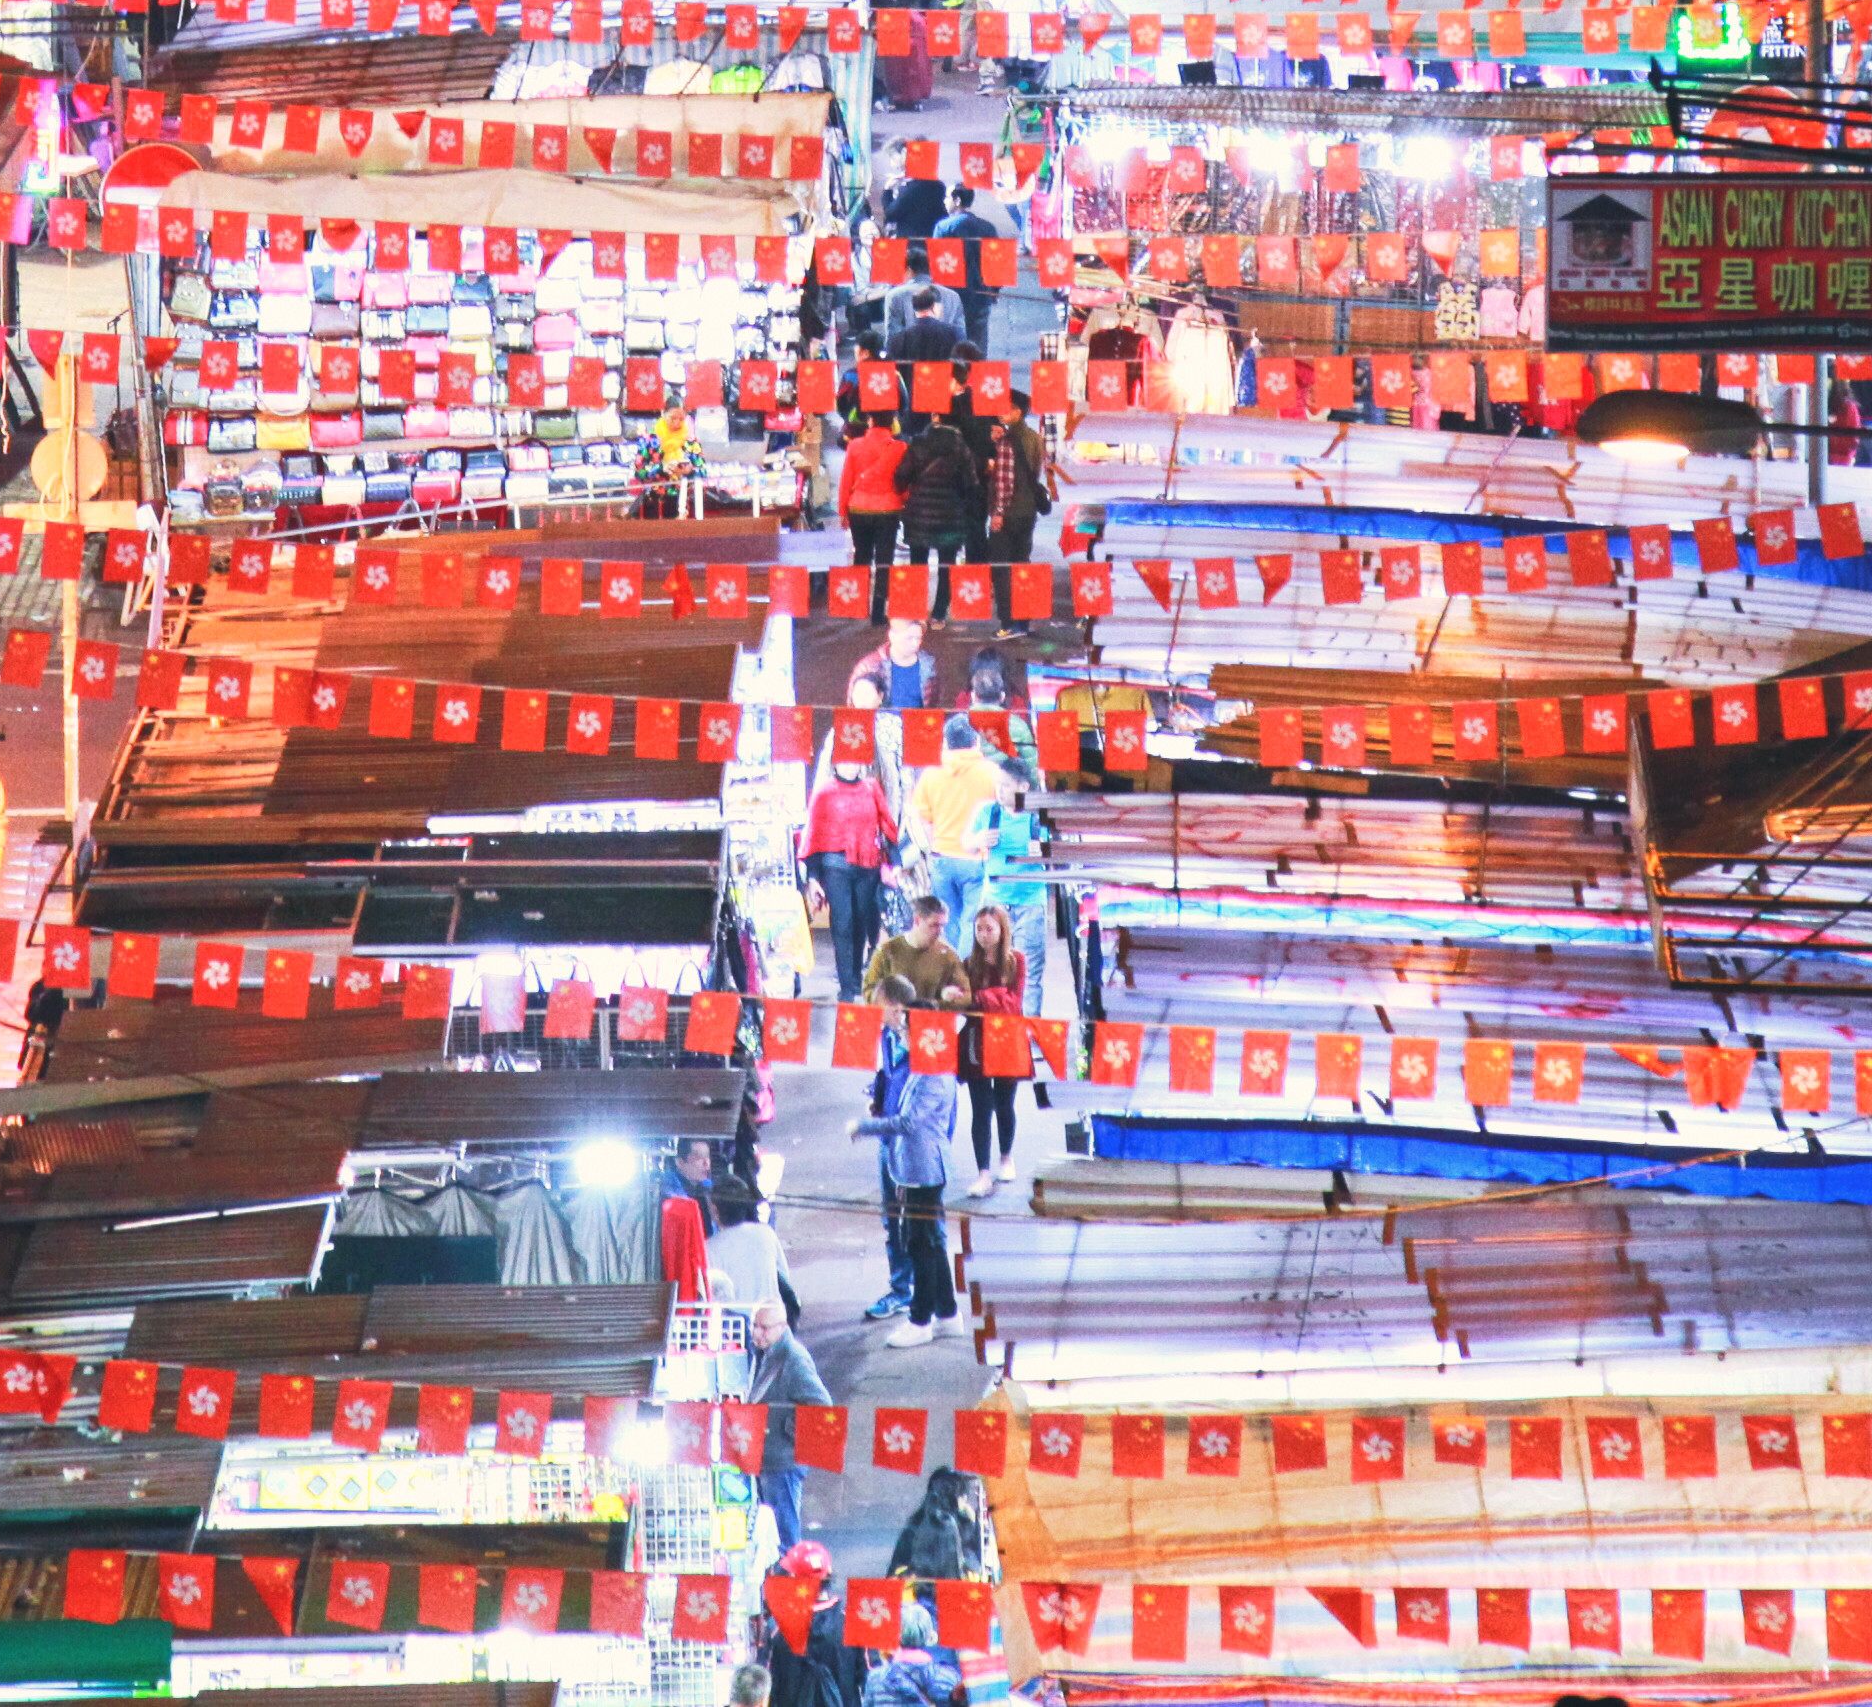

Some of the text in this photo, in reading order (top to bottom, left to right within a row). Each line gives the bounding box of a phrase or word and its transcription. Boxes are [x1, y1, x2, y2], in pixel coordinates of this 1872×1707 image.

[1759, 44, 1807, 58] FITTIN
[1658, 188, 1872, 248] ASIAN CURRY KITCHEN
